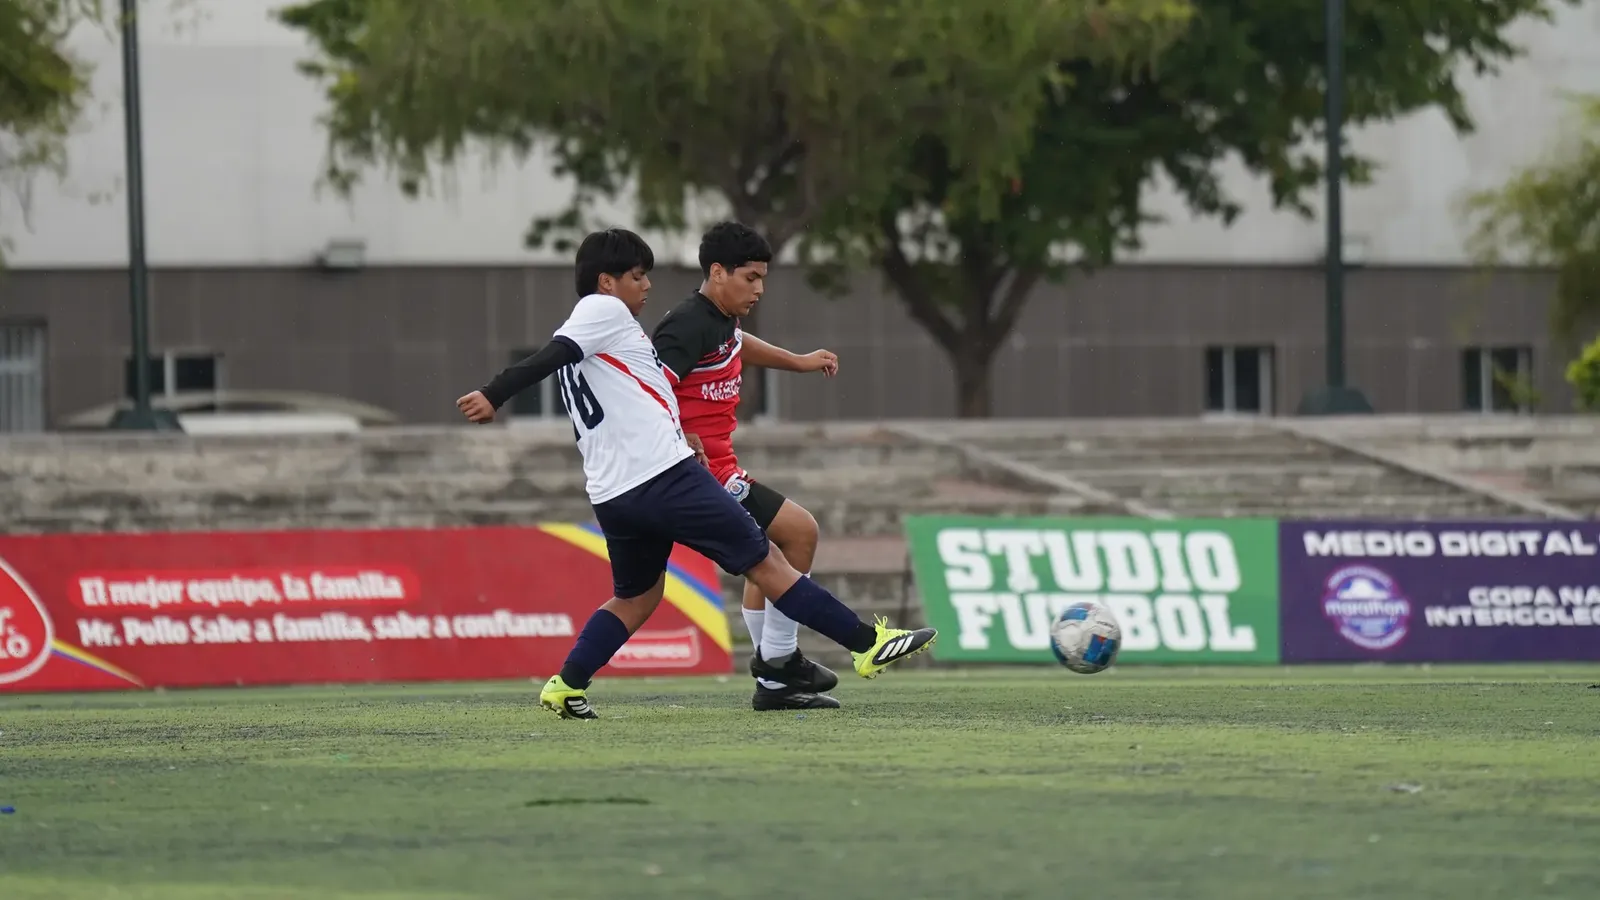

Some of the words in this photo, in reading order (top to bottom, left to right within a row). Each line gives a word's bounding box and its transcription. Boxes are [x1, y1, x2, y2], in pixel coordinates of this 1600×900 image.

[937, 529, 1241, 592] STUDIO
[1303, 532, 1435, 556] MEDIO
[1439, 532, 1596, 556] DIGITAL
[79, 576, 108, 606] El
[109, 576, 184, 609] mejor
[186, 575, 281, 607] equipo,
[281, 573, 309, 601] la
[309, 571, 404, 600] familia
[1468, 587, 1556, 606] COPA
[77, 619, 121, 647] Mr.
[122, 616, 189, 645] Pollo
[189, 614, 252, 644] Sabe
[254, 619, 273, 642] a
[273, 612, 373, 643] familia,
[373, 611, 432, 640] sabe
[433, 615, 453, 638] a
[453, 609, 574, 638] confianza
